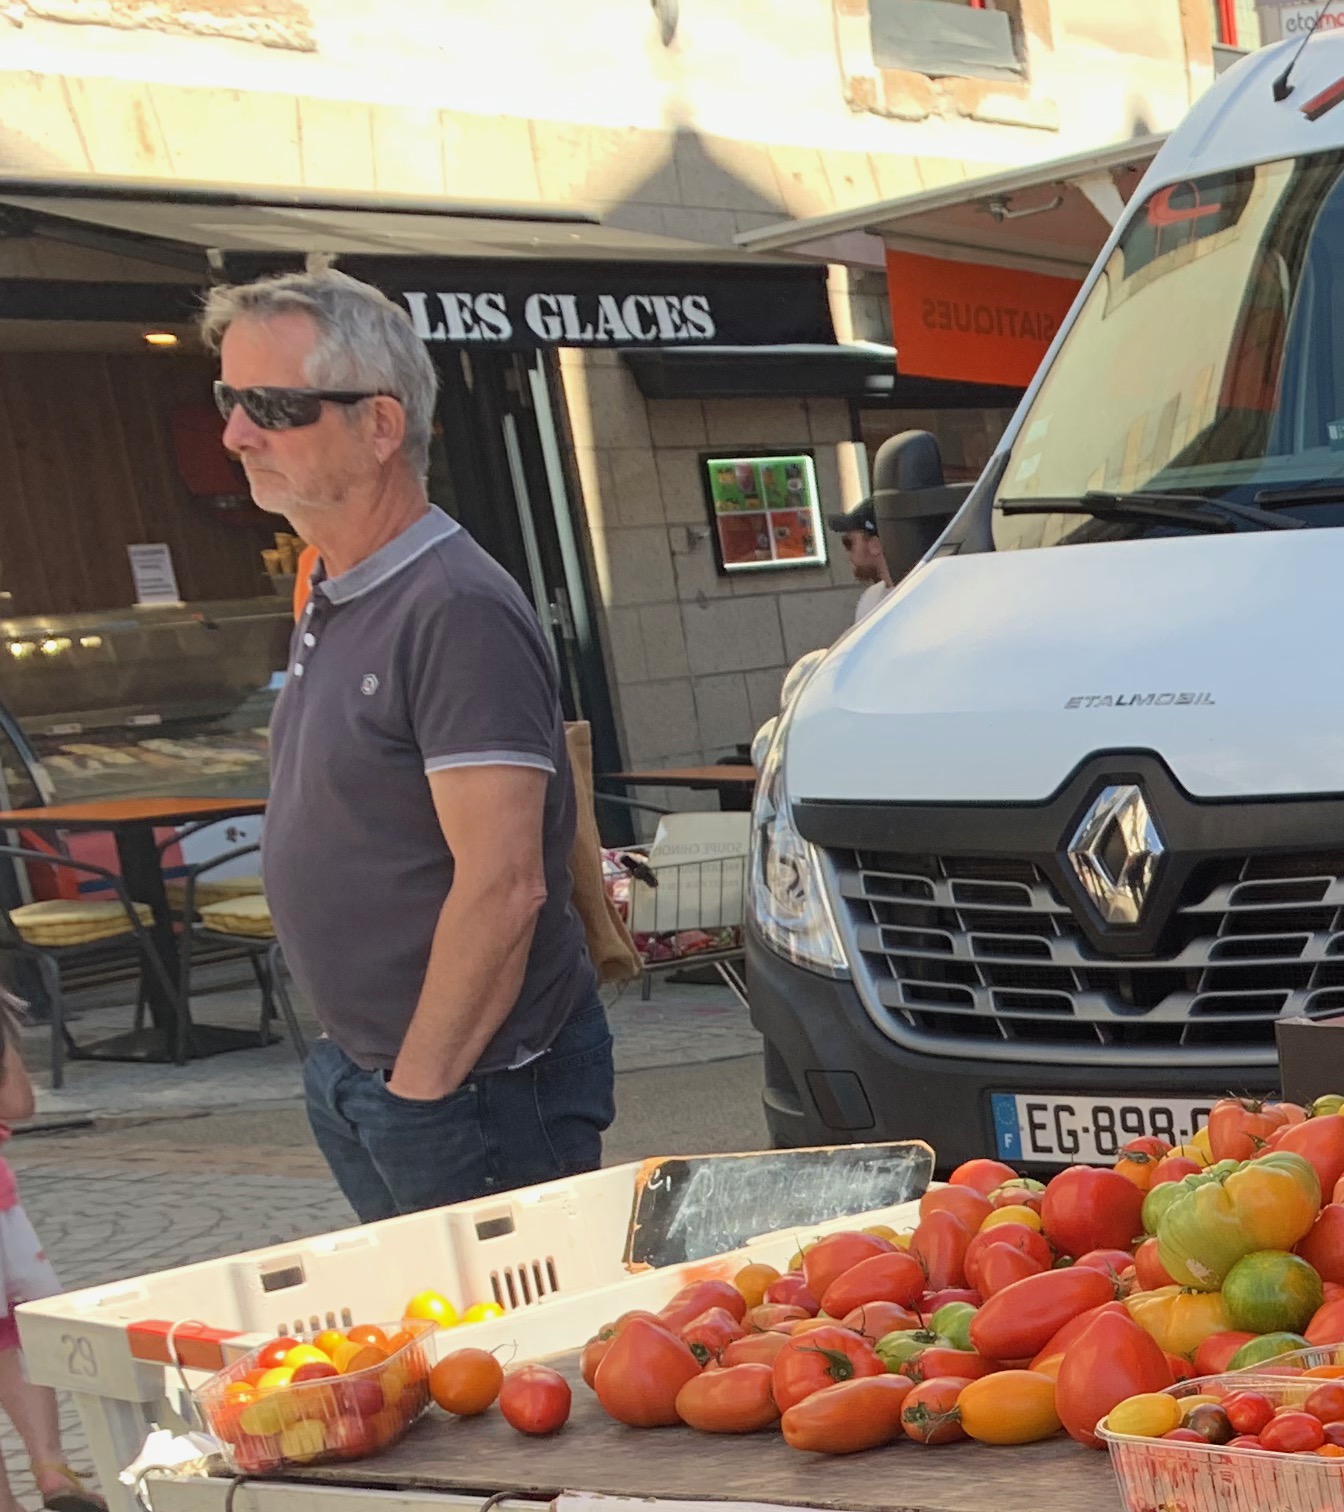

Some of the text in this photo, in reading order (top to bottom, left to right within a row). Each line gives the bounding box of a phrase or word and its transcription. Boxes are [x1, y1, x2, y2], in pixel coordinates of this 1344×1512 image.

[402, 292, 716, 341] LES GLACES
[1064, 691, 1216, 710] ETALMOBIL
[1004, 1134, 1013, 1149] F
[1026, 1103, 1212, 1155] EG-898-
[61, 1334, 97, 1378] 29
